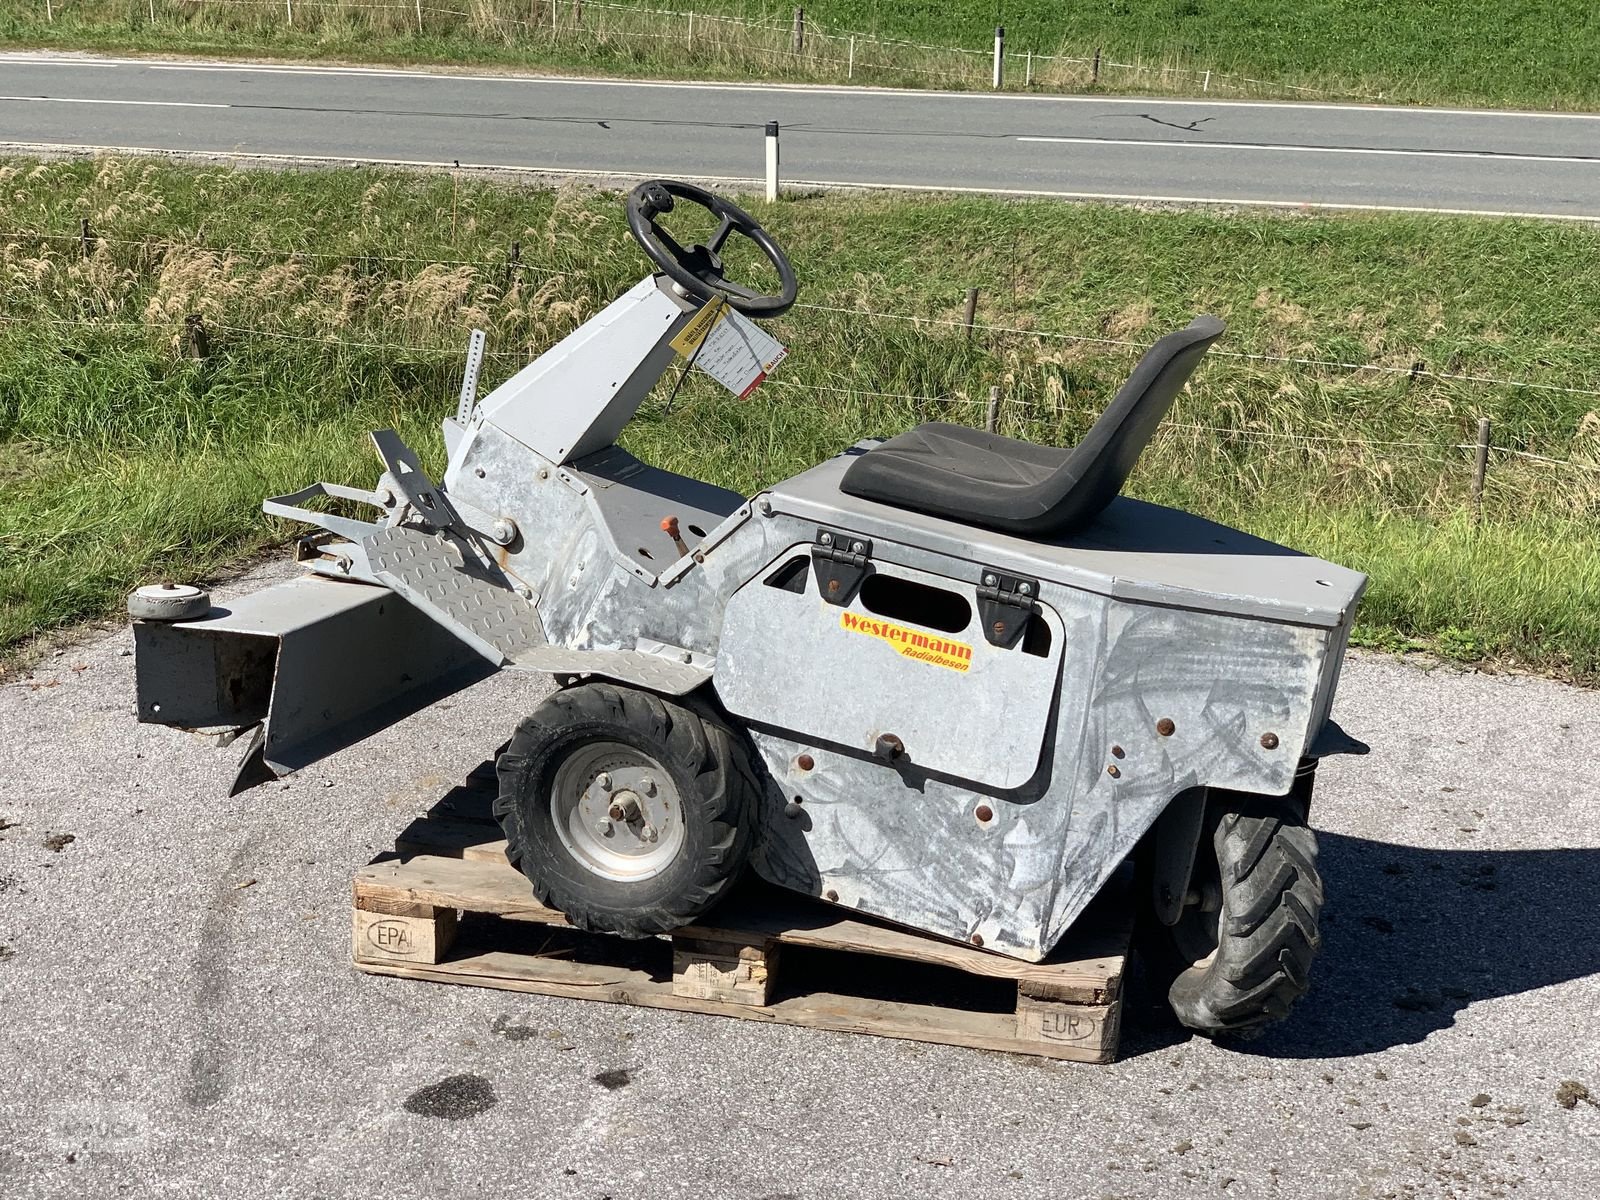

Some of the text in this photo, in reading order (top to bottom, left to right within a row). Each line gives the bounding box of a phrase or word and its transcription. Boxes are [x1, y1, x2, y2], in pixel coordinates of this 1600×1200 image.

[766, 351, 785, 371] MAUCH
[843, 612, 972, 661] Westermann
[902, 647, 969, 671] Radialbesen
[1042, 1011, 1080, 1036] EUR
